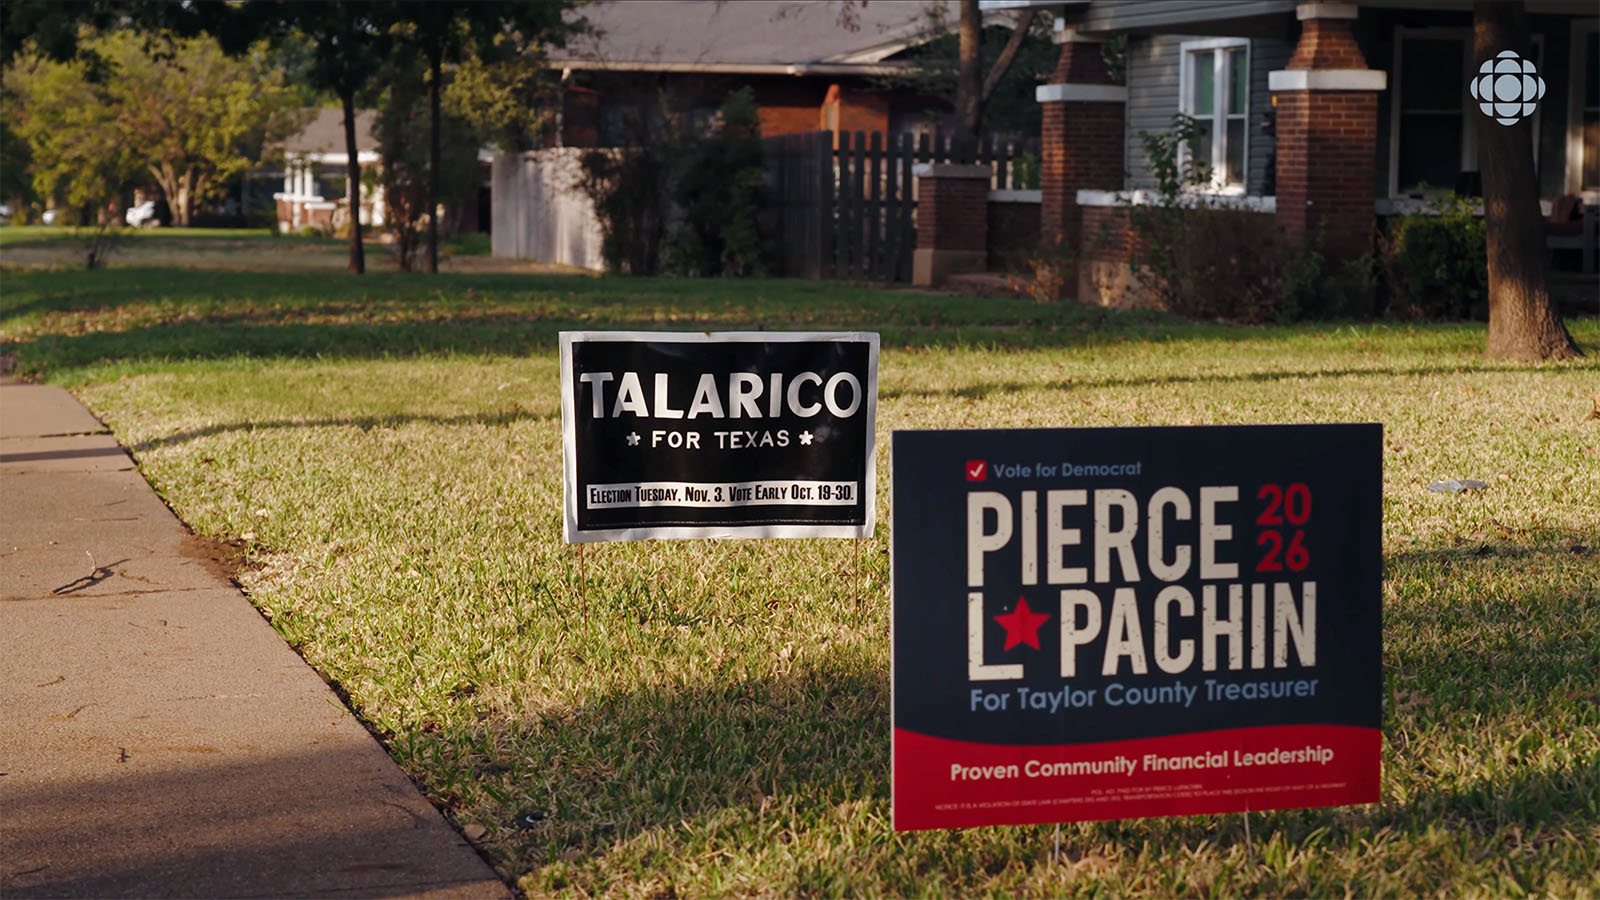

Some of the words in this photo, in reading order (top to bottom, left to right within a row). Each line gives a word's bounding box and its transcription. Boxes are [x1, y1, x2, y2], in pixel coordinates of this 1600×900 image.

[579, 371, 862, 420] TALARICO
[651, 430, 702, 450] FOR
[713, 429, 791, 450] TEXAS
[992, 463, 1032, 479] Vote
[1035, 462, 1057, 478] for
[1061, 461, 1142, 478] Democrat
[713, 486, 726, 503] 3.
[817, 483, 855, 501] 19-30.
[1256, 483, 1312, 526] 20
[967, 485, 1240, 587] PIERCE
[1256, 529, 1311, 572] 26
[970, 689, 1010, 712] For
[1017, 685, 1097, 714] Taylor
[1104, 680, 1198, 708] County
[1204, 677, 1320, 702] Treasurer
[950, 762, 1019, 782] Proven
[1024, 755, 1138, 778] Community
[1142, 749, 1229, 771] Financial
[1233, 744, 1334, 768] Leadership
